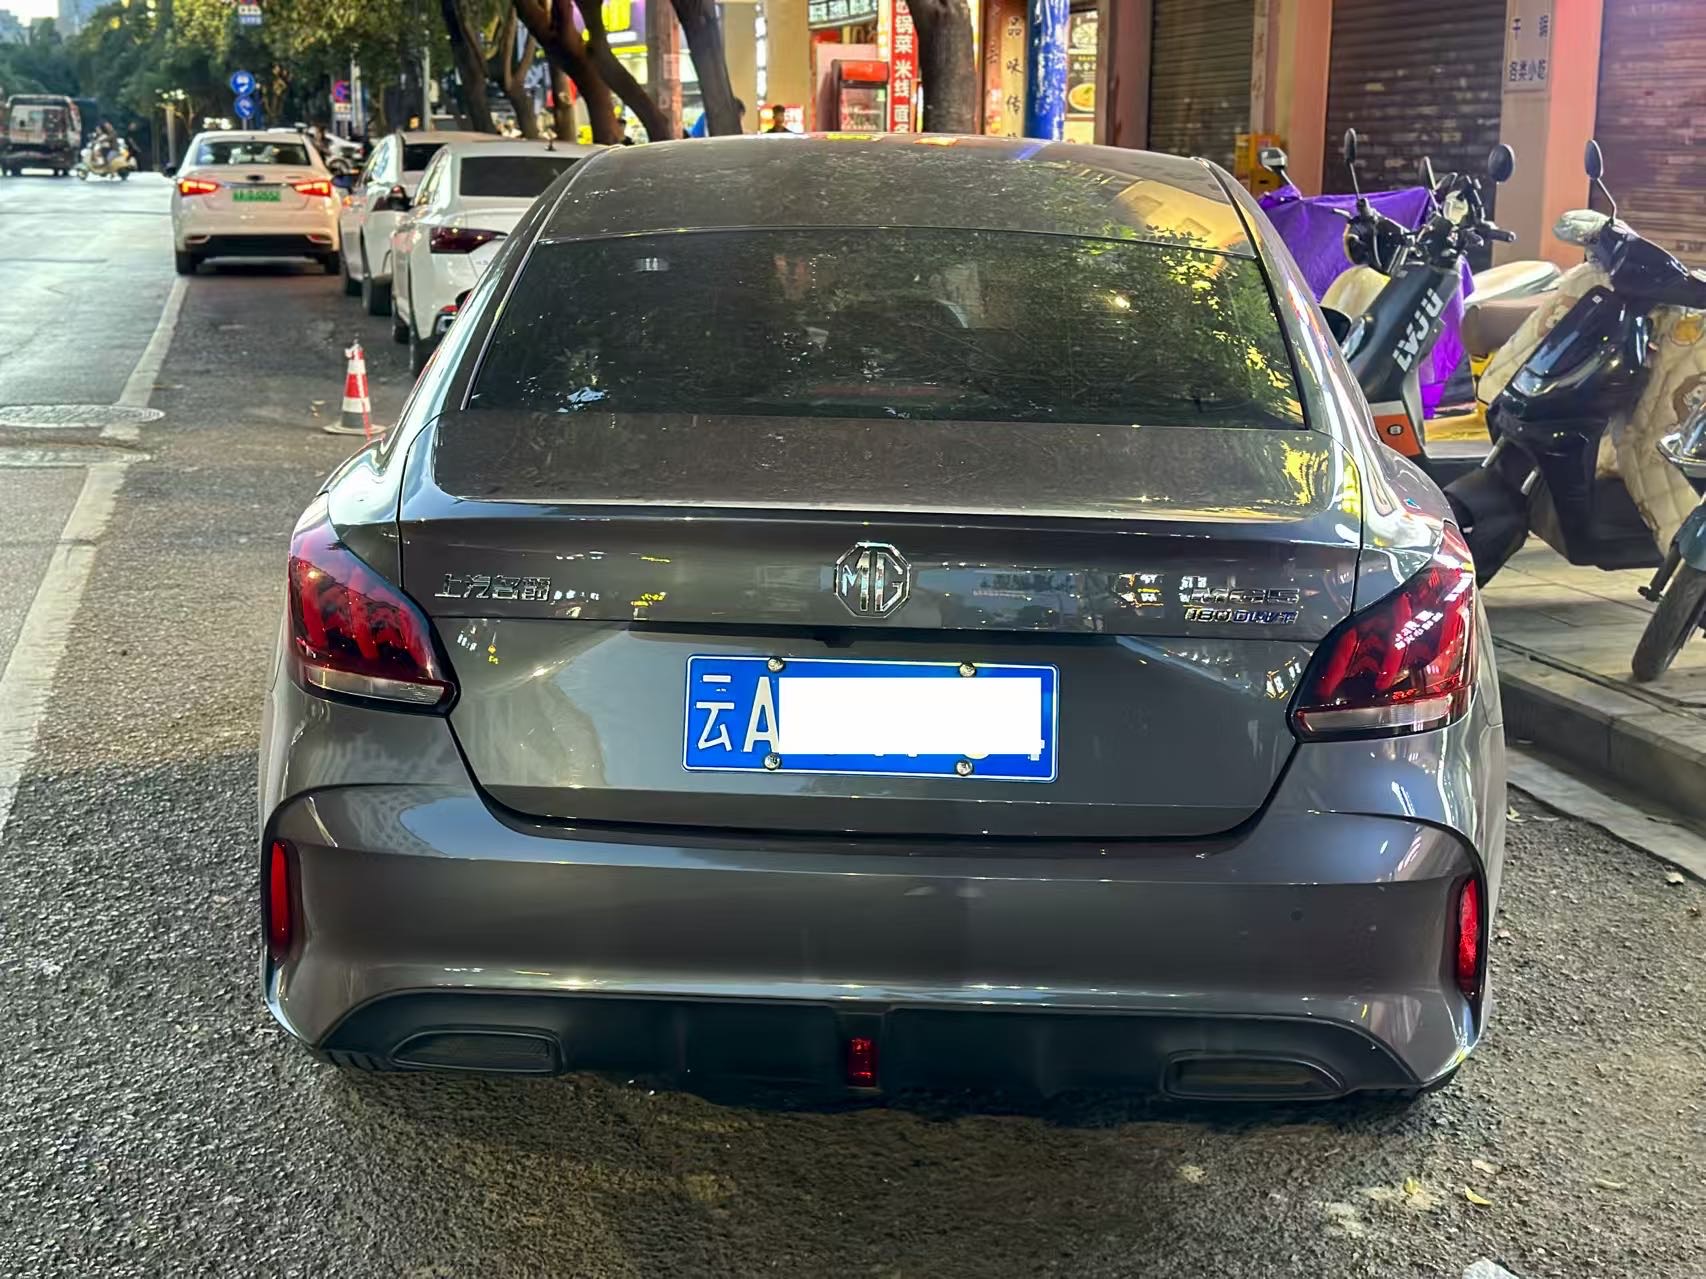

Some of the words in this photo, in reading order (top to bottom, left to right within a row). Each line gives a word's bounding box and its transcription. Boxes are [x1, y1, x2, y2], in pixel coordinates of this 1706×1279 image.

[434, 573, 551, 601] 上汽名爵
[841, 551, 904, 612] MG
